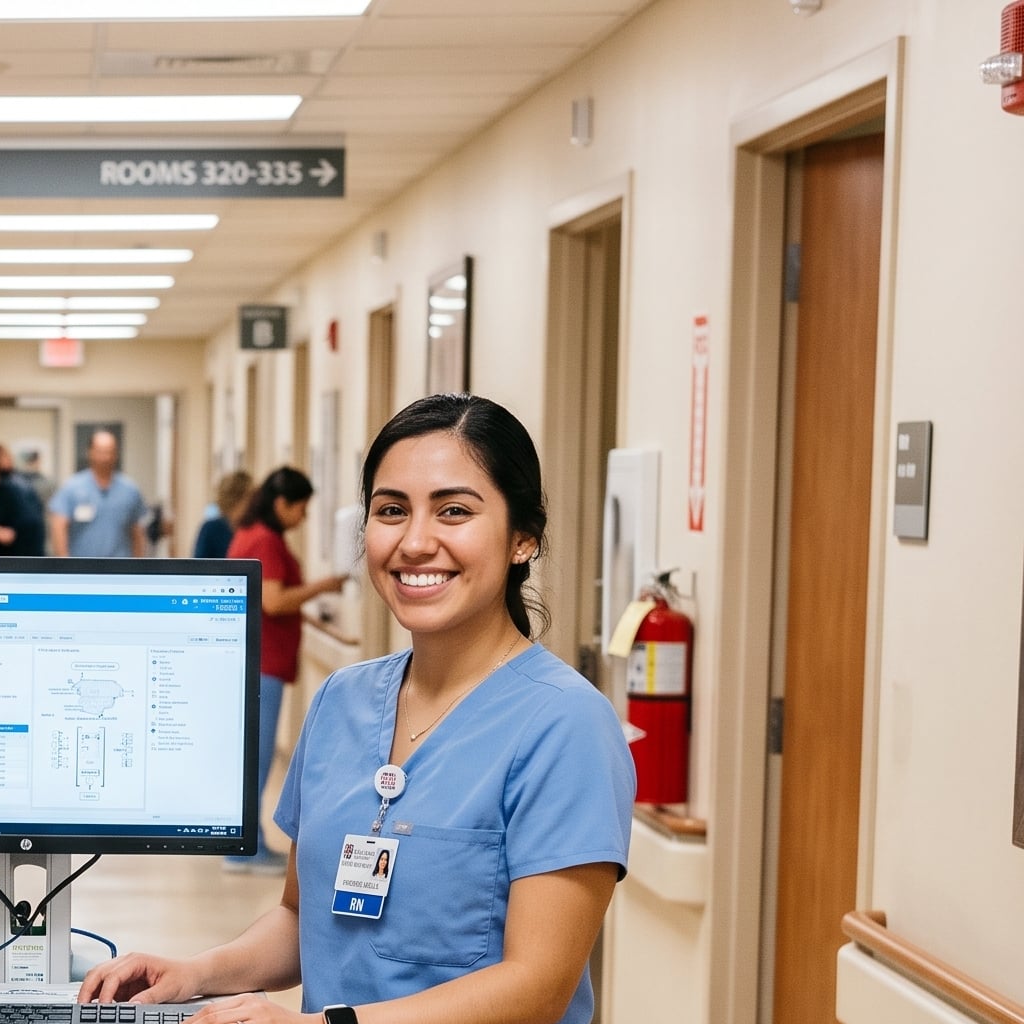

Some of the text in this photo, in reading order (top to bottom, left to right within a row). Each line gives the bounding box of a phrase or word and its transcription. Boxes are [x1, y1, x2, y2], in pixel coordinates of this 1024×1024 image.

[100, 159, 303, 186] ROOMS 320-335
[349, 897, 365, 912] RN
